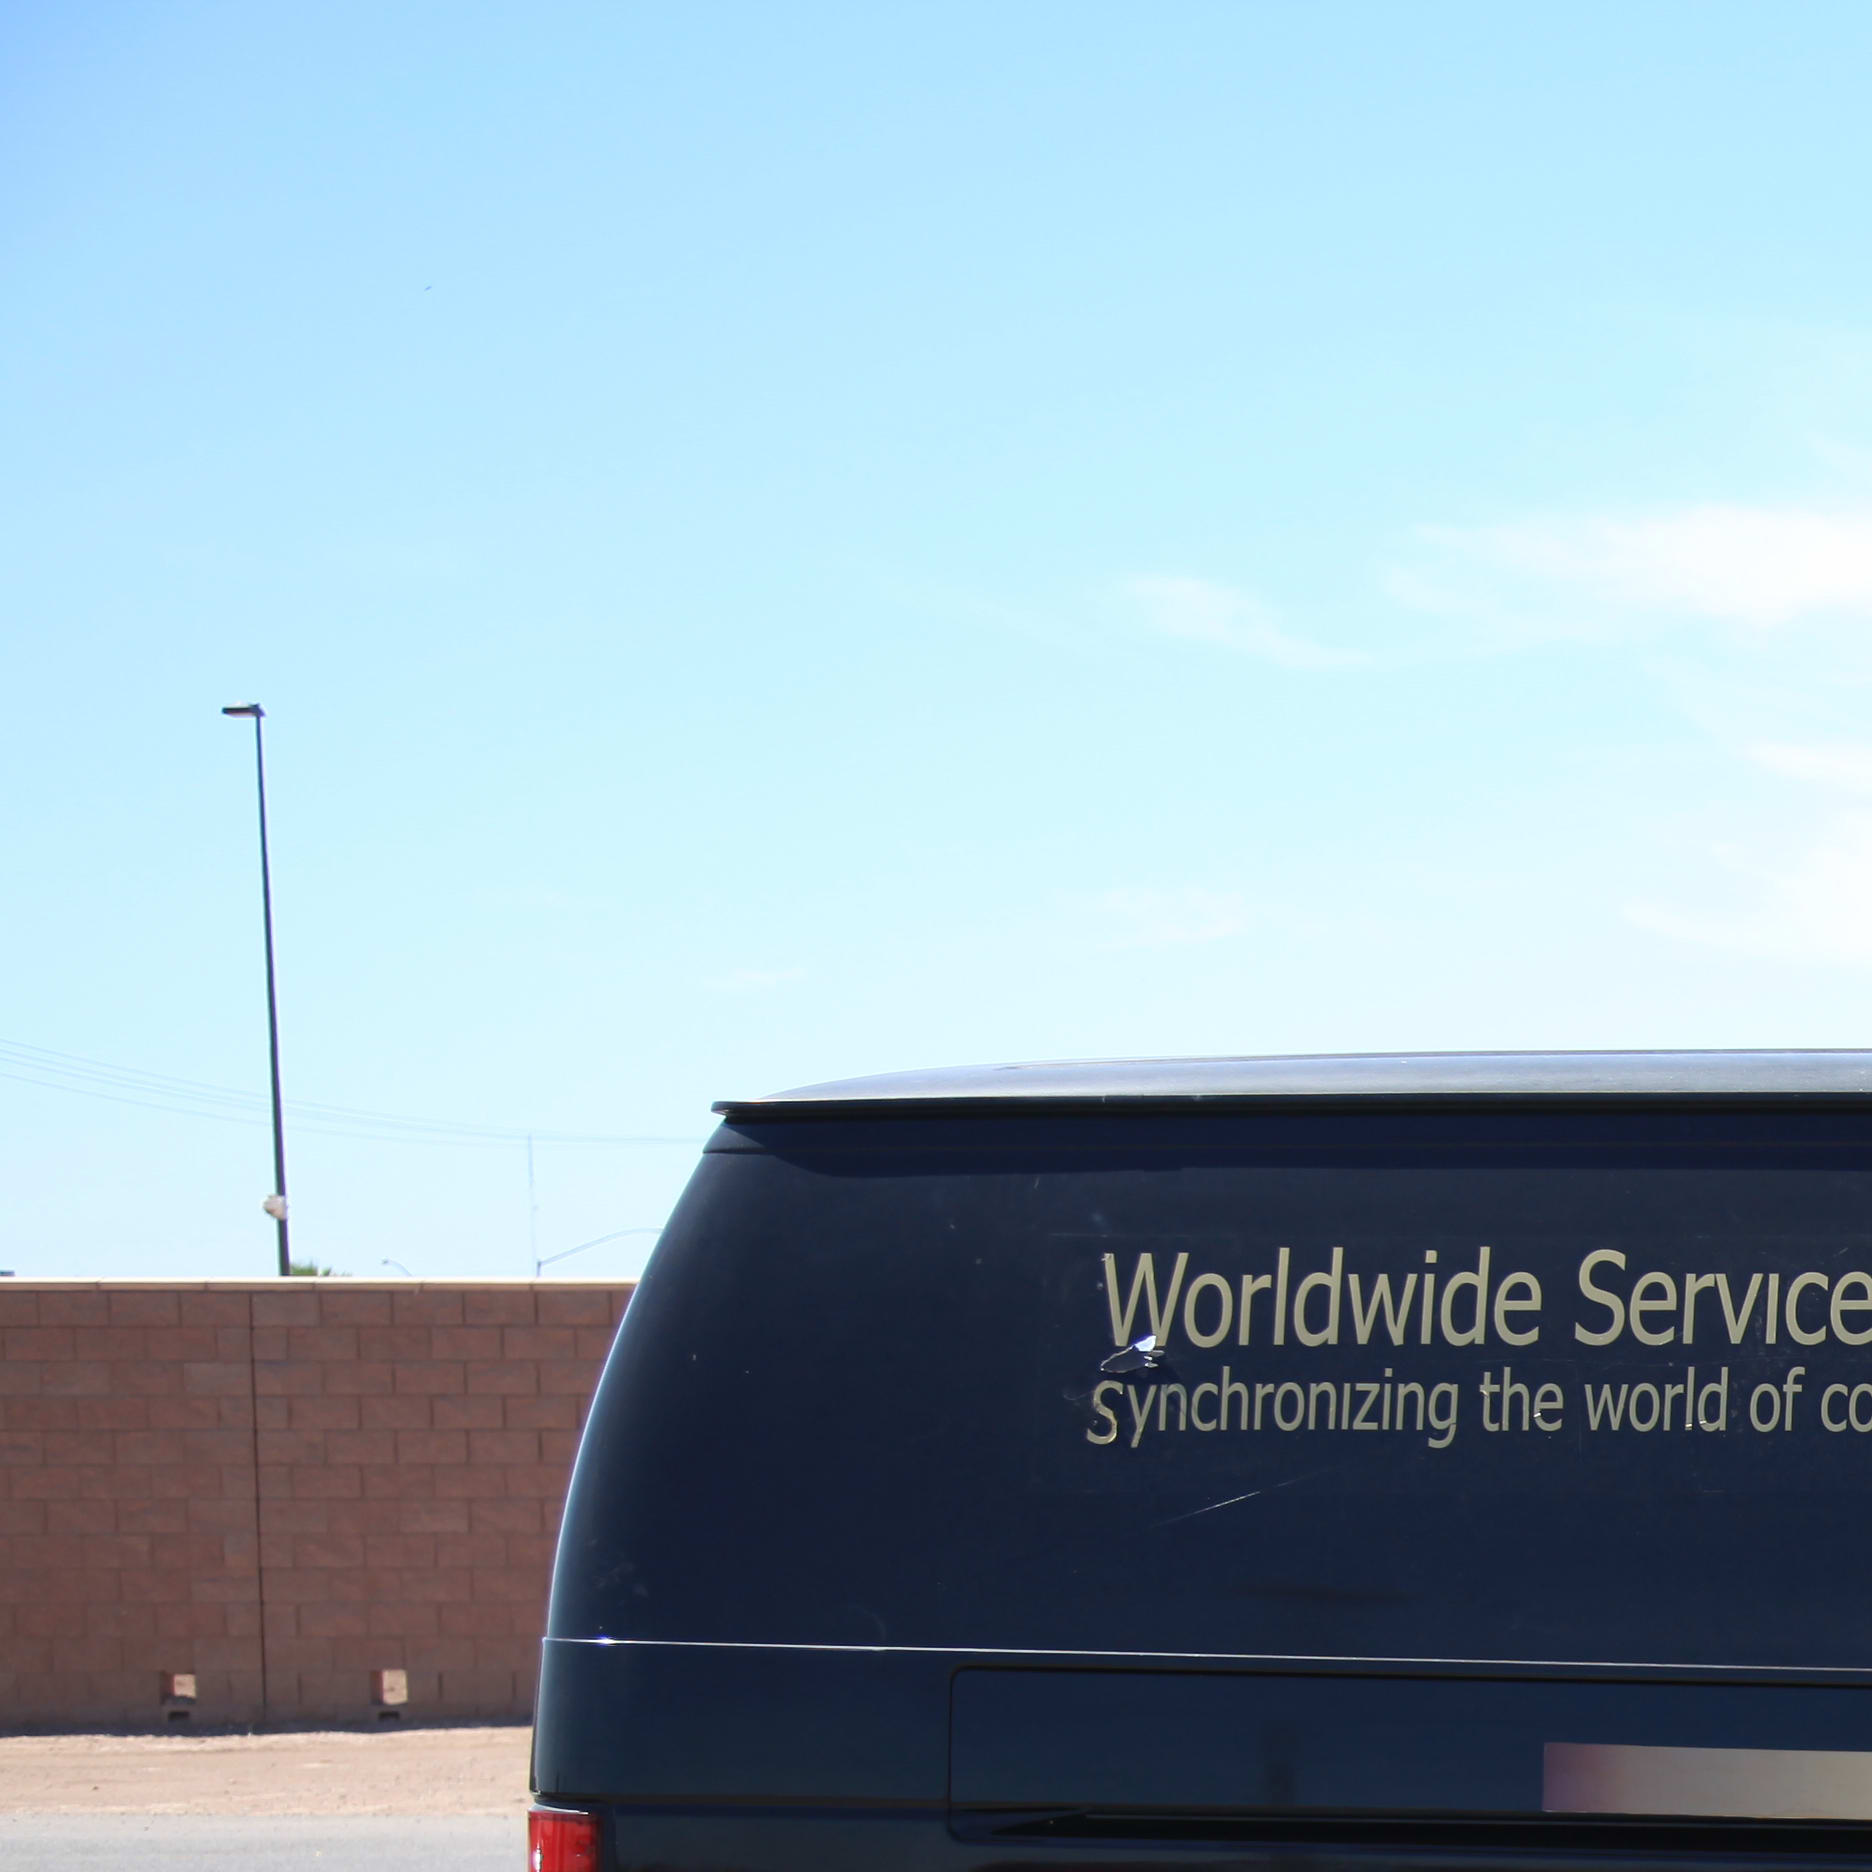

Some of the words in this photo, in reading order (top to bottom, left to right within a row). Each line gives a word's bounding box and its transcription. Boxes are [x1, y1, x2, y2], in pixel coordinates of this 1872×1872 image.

[1101, 1246, 1543, 1347] Worldwide
[1085, 1365, 1459, 1449] Synchronizing
[1479, 1366, 1564, 1432] the
[1584, 1366, 1729, 1432] world
[1749, 1366, 1807, 1433] of
